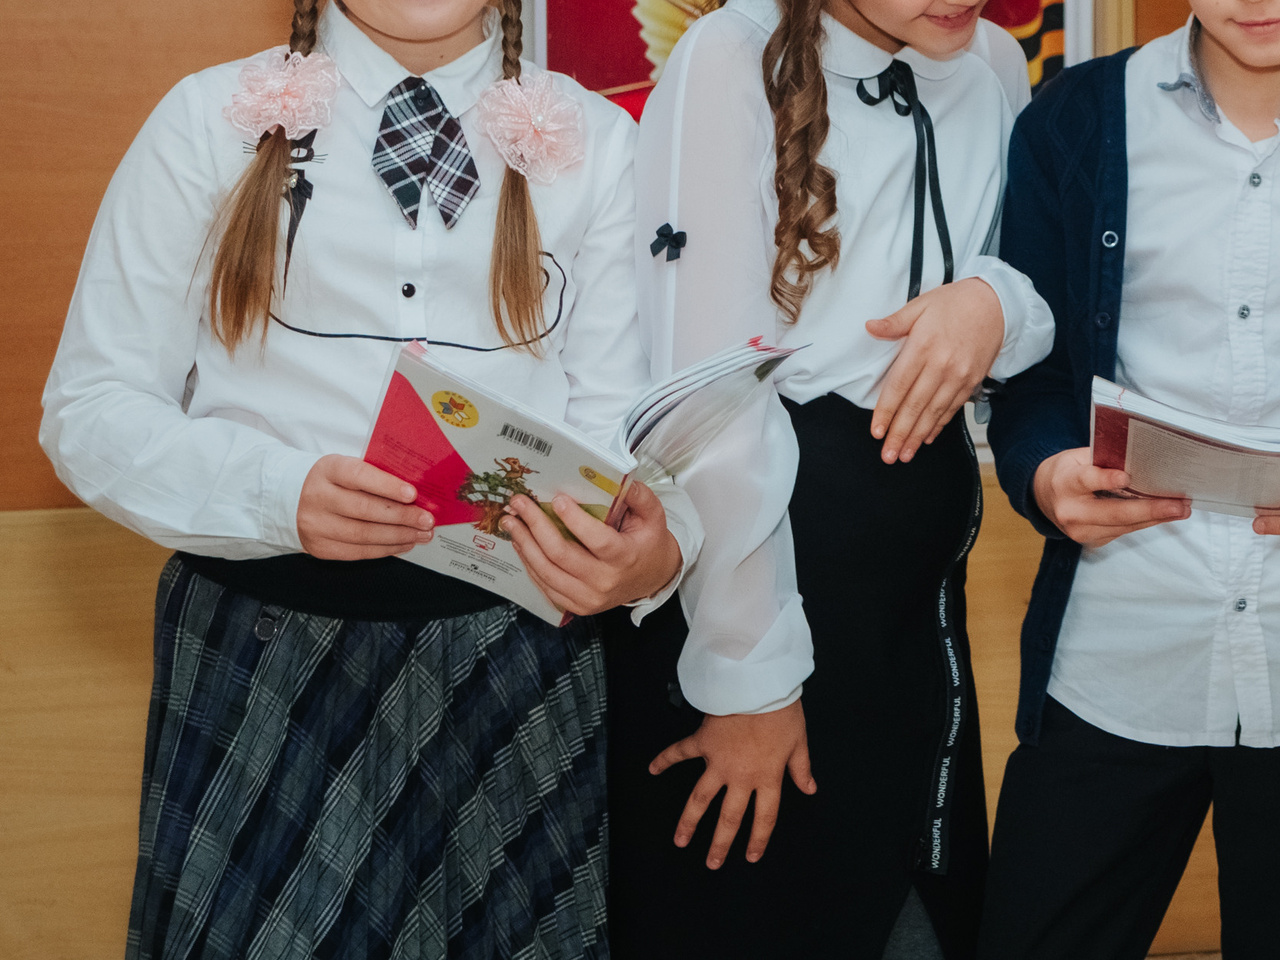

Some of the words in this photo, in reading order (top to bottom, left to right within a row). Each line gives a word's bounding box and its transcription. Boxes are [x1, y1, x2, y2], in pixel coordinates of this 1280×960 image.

[945, 637, 960, 687] WONDERFUL
[947, 696, 962, 747] WONDERFUL
[936, 756, 951, 808] WONDERFUL
[931, 817, 943, 869] WONDERFUL
